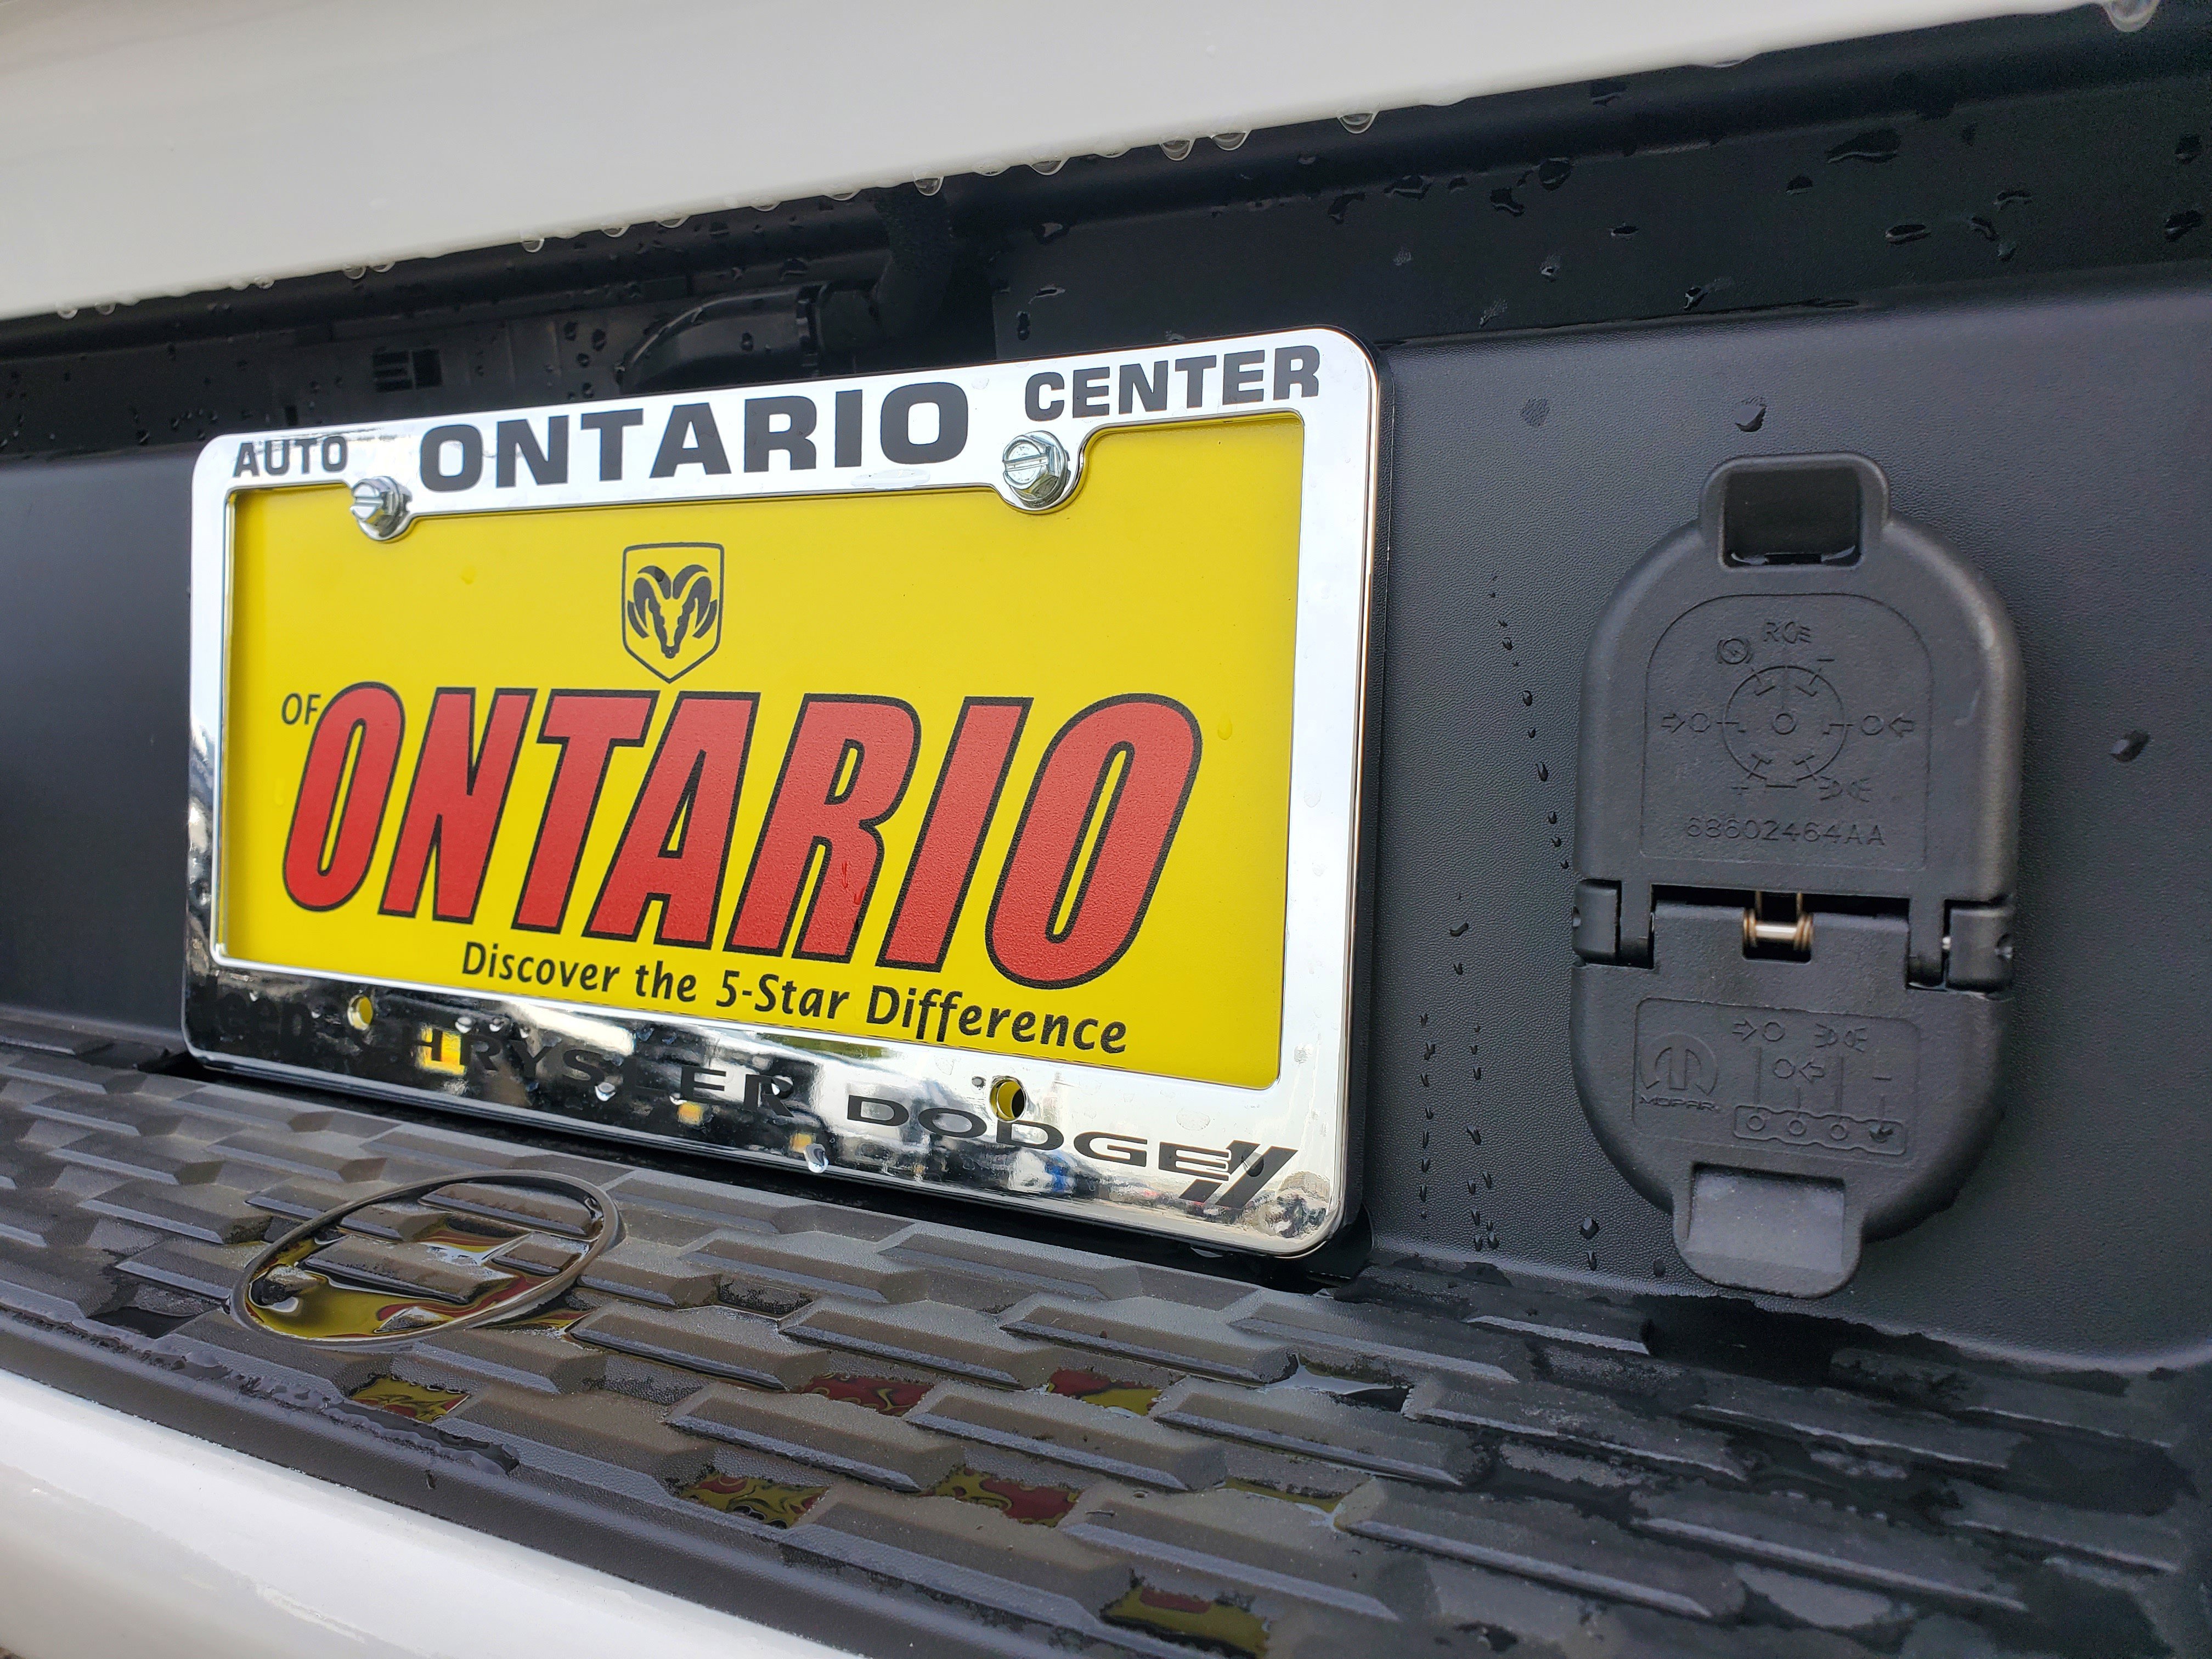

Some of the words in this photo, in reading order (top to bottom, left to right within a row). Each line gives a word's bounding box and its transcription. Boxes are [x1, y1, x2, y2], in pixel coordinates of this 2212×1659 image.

[232, 435, 348, 478] AUTO
[420, 381, 968, 493] ONTARIO
[1024, 345, 1321, 421] CENTER
[281, 692, 321, 725] OF
[282, 681, 1203, 990] ONTARIO
[1686, 816, 1886, 846] 68602464AA
[462, 941, 620, 992] Discover
[635, 960, 697, 1002] the
[716, 969, 850, 1019] 5-Star
[866, 984, 1127, 1054] Difference
[846, 1094, 1230, 1181] DODGE
[1639, 1094, 1716, 1111] MOPAR
